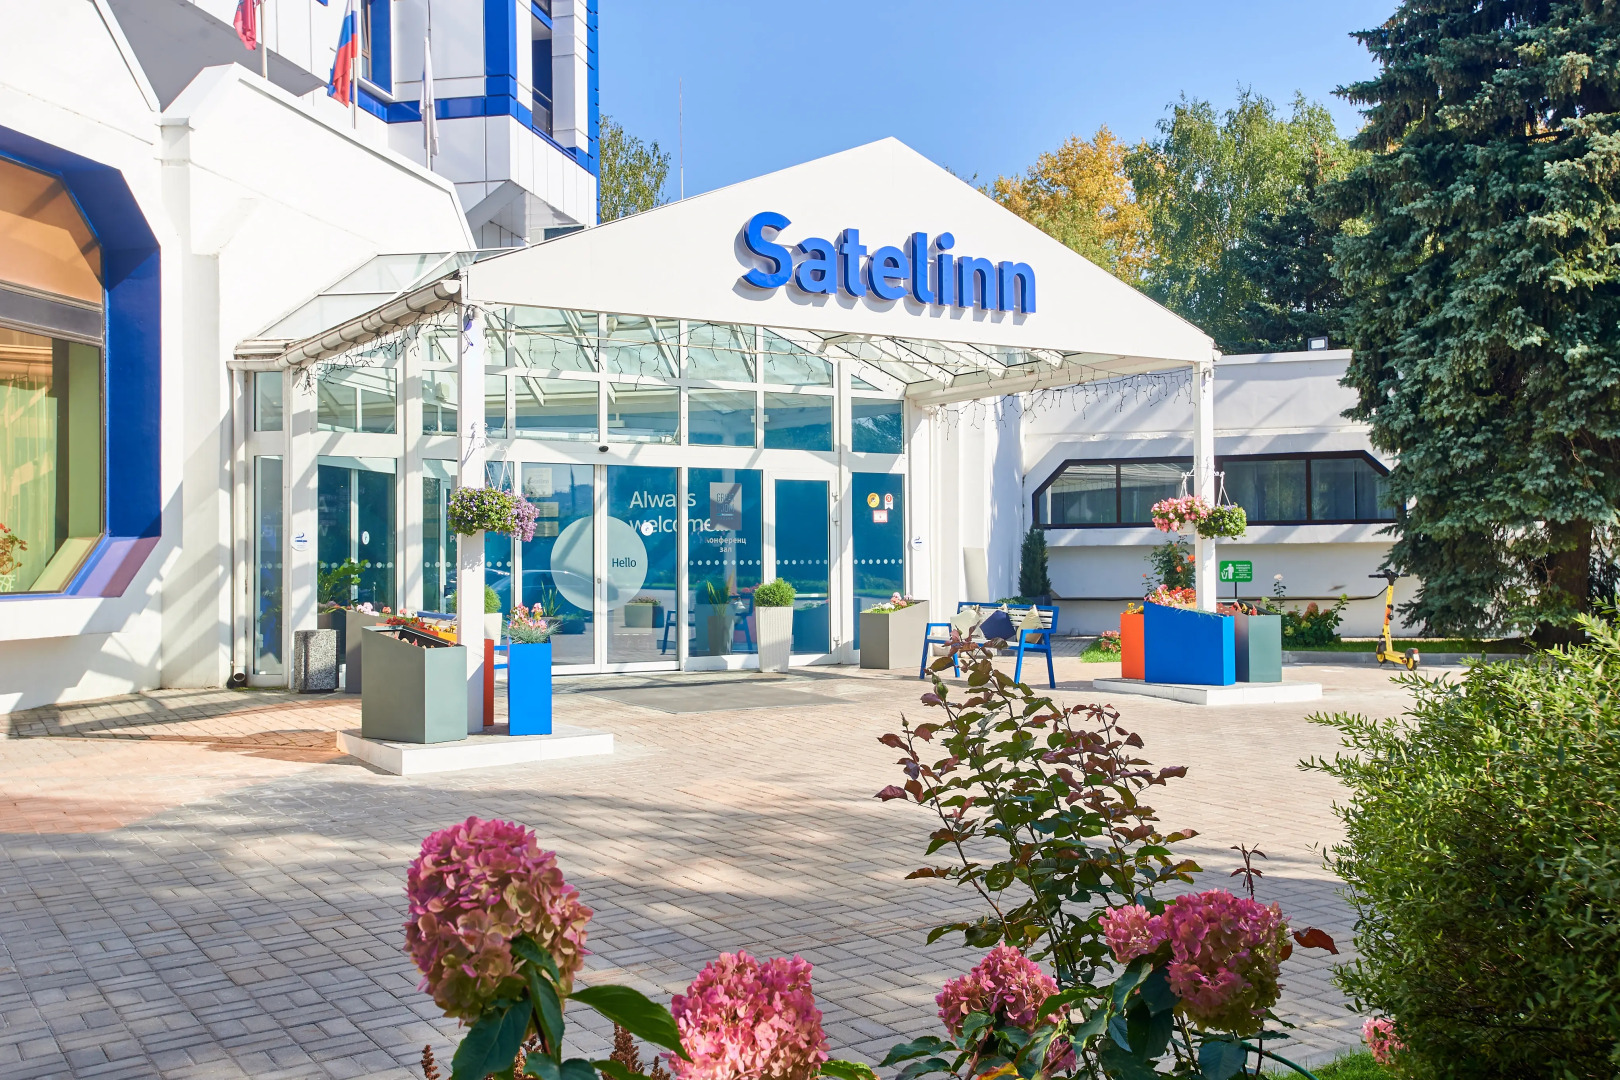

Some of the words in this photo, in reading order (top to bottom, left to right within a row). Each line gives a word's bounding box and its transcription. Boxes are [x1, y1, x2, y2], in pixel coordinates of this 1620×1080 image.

[742, 211, 1036, 313] Satelinn
[629, 491, 697, 509] Alwas
[611, 557, 637, 568] Hello
